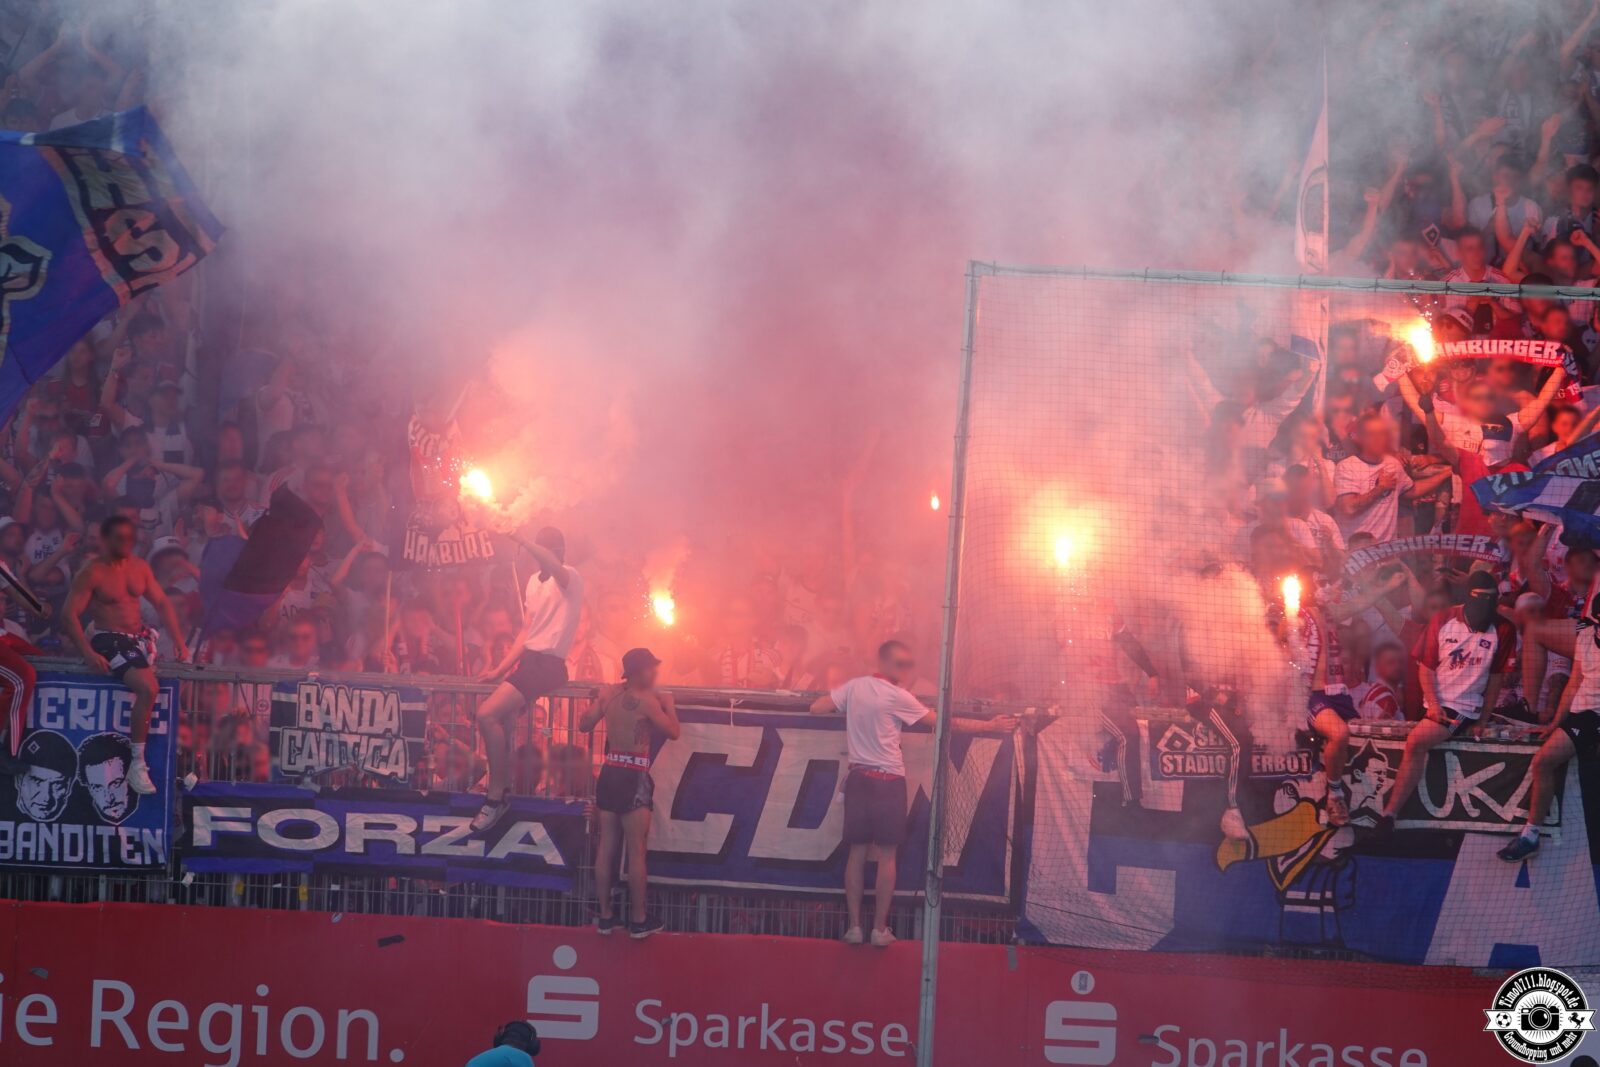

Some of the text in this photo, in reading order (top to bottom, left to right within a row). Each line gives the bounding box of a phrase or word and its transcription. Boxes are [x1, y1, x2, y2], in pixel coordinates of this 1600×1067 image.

[298, 684, 400, 735] BANDA
[193, 806, 565, 865] FORZA
[90, 979, 405, 1067] Region.
[633, 999, 910, 1058] Sparkasse
[1151, 1024, 1428, 1067] Sparkasse
